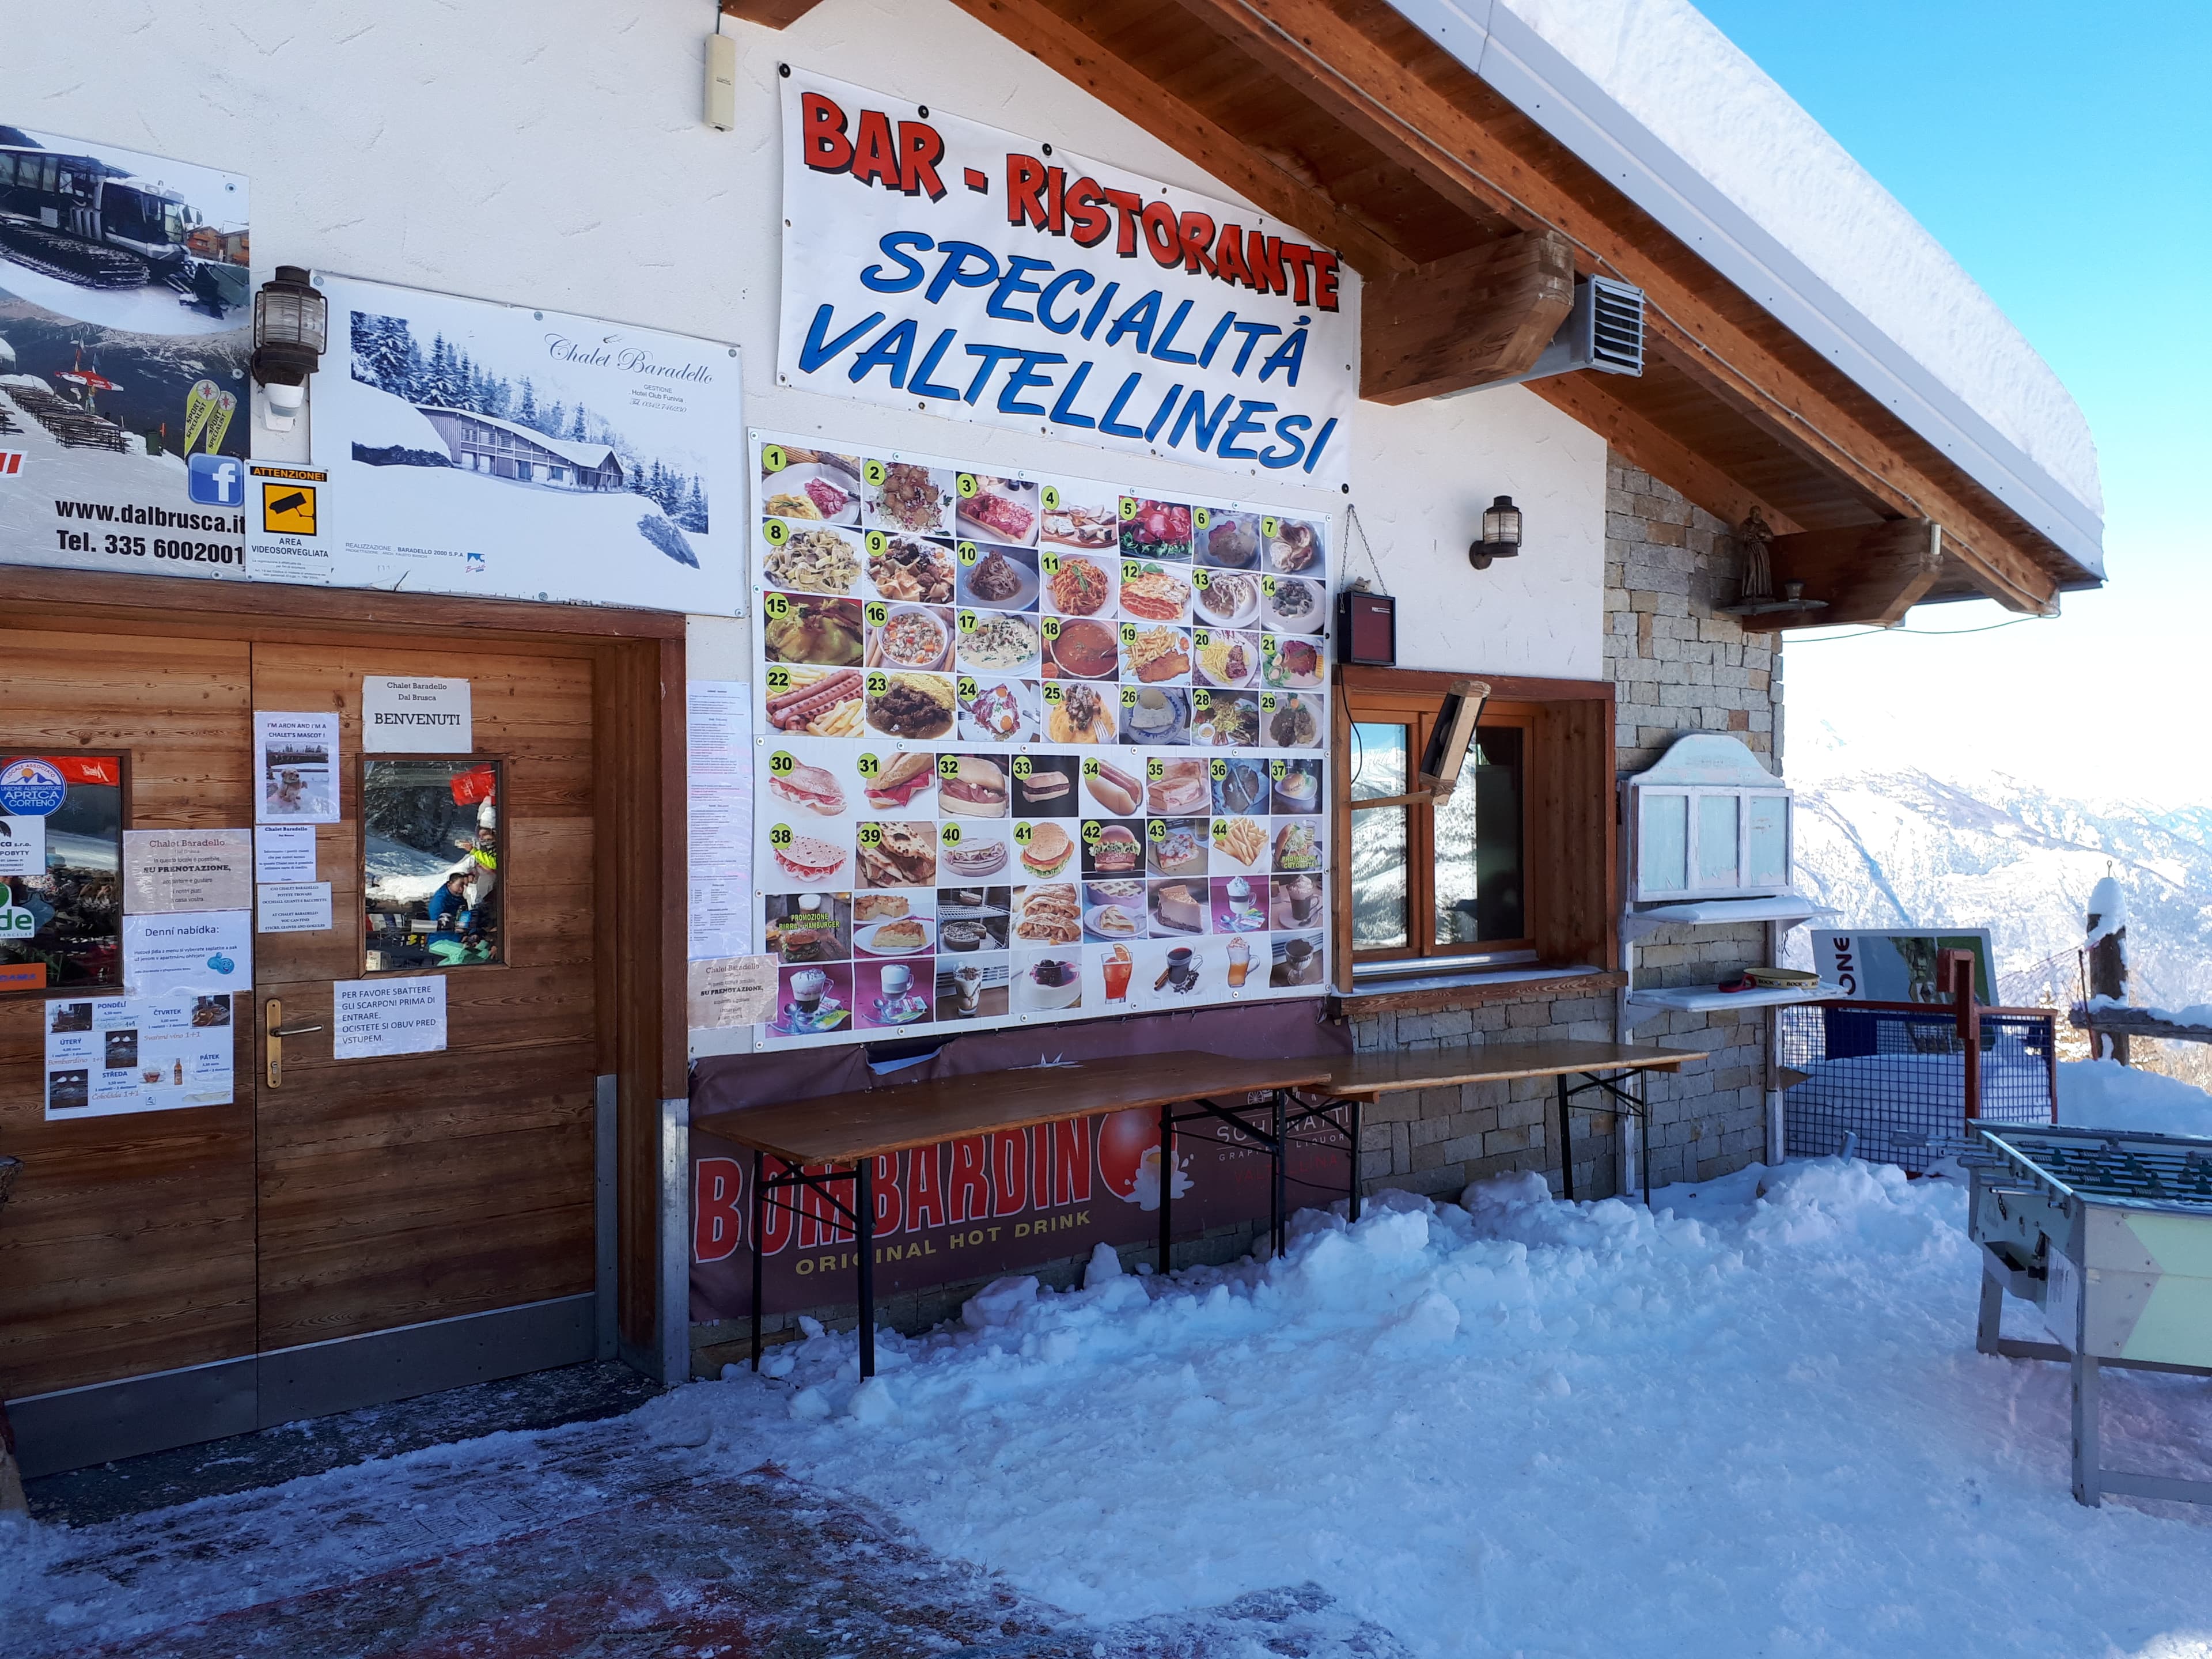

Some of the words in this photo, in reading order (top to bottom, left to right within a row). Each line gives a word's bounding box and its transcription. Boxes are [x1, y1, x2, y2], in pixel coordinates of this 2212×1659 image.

[801, 91, 947, 203] BAR
[1006, 153, 1339, 312] RISTORANTE
[544, 333, 610, 368] Chalet
[618, 347, 713, 384] Baradello
[644, 384, 672, 393] GESTIONE
[798, 303, 1337, 473] VALTELLINESI
[663, 394, 684, 403] Funivia
[187, 399, 201, 425] SPORT
[186, 402, 206, 438] SPECIALIST
[209, 410, 222, 435] SPORT
[209, 413, 226, 449] SPECIALIST
[771, 452, 778, 465] 1
[253, 467, 325, 481] ATTENZIONE!
[870, 466, 879, 480] 2
[963, 479, 971, 493] 3
[1046, 492, 1054, 505] 4
[1124, 502, 1131, 515] 5
[55, 500, 245, 534] www.dalbrusca.it
[1198, 513, 1205, 524] 6
[771, 525, 781, 539] 8
[1266, 521, 1273, 533] 7
[56, 529, 96, 553] Tel.
[105, 535, 145, 556] 335
[154, 538, 243, 565] 6002001
[279, 537, 302, 546] AREA
[346, 543, 391, 551] REALIZZAZIONE
[872, 537, 881, 550] 9
[251, 545, 328, 558] VIDEOSORVEGLIATA
[959, 547, 976, 561] 10
[1043, 557, 1059, 570] 11
[1123, 565, 1138, 578] 12
[1194, 573, 1209, 585] 13
[1262, 580, 1275, 592] 14
[767, 599, 787, 613] 15
[868, 607, 885, 621] 16
[959, 615, 975, 628] 17
[1044, 622, 1058, 635] 18
[1122, 628, 1135, 641] 19
[1195, 634, 1209, 646] 20
[1263, 639, 1275, 650] 21
[768, 672, 789, 687] 22
[868, 677, 887, 691] 23
[959, 683, 976, 696] 24
[1044, 687, 1060, 699] 25
[1122, 691, 1135, 703] 26
[1193, 694, 1209, 707] 28
[1262, 697, 1275, 709] 29
[374, 713, 460, 725] BENVENUTI
[771, 756, 792, 771] 30
[859, 759, 878, 772] 31
[940, 760, 958, 774] 32
[1014, 762, 1031, 774] 33
[1084, 763, 1099, 775] 34
[1149, 764, 1163, 775] 35
[1211, 764, 1226, 776] 36
[1272, 764, 1286, 776] 37
[6, 764, 24, 779] LOCALE
[26, 763, 55, 778] ASSOCIATO
[4, 791, 59, 800] APRICA
[9, 799, 56, 807] CORTENO
[861, 829, 881, 843] 39
[942, 828, 960, 841] 40
[1016, 827, 1031, 840] 41
[1084, 826, 1100, 838] 42
[1149, 825, 1165, 837] 43
[1213, 824, 1227, 835] 44
[182, 839, 225, 847] Baradello
[771, 830, 791, 843] 38
[791, 913, 829, 921] PROMOZIONE
[145, 927, 175, 937] Denní
[177, 925, 219, 935] nabídka:
[359, 988, 391, 998] FAVORE
[393, 986, 431, 995] SBATTERE
[711, 986, 763, 995] PRENOTAZIONE,
[357, 999, 397, 1009] SCARPONI
[399, 997, 425, 1006] PRIMA
[342, 1012, 381, 1021] ENTRARE.
[342, 1023, 380, 1033] OCISTETE
[391, 1020, 414, 1029] OBUV
[416, 1018, 436, 1027] PRED
[342, 1035, 384, 1044] VSTUPEM.
[1235, 1154, 1337, 1183] VALTLLINA
[950, 1226, 1002, 1250] HOT
[1014, 1210, 1091, 1239] DRINK
